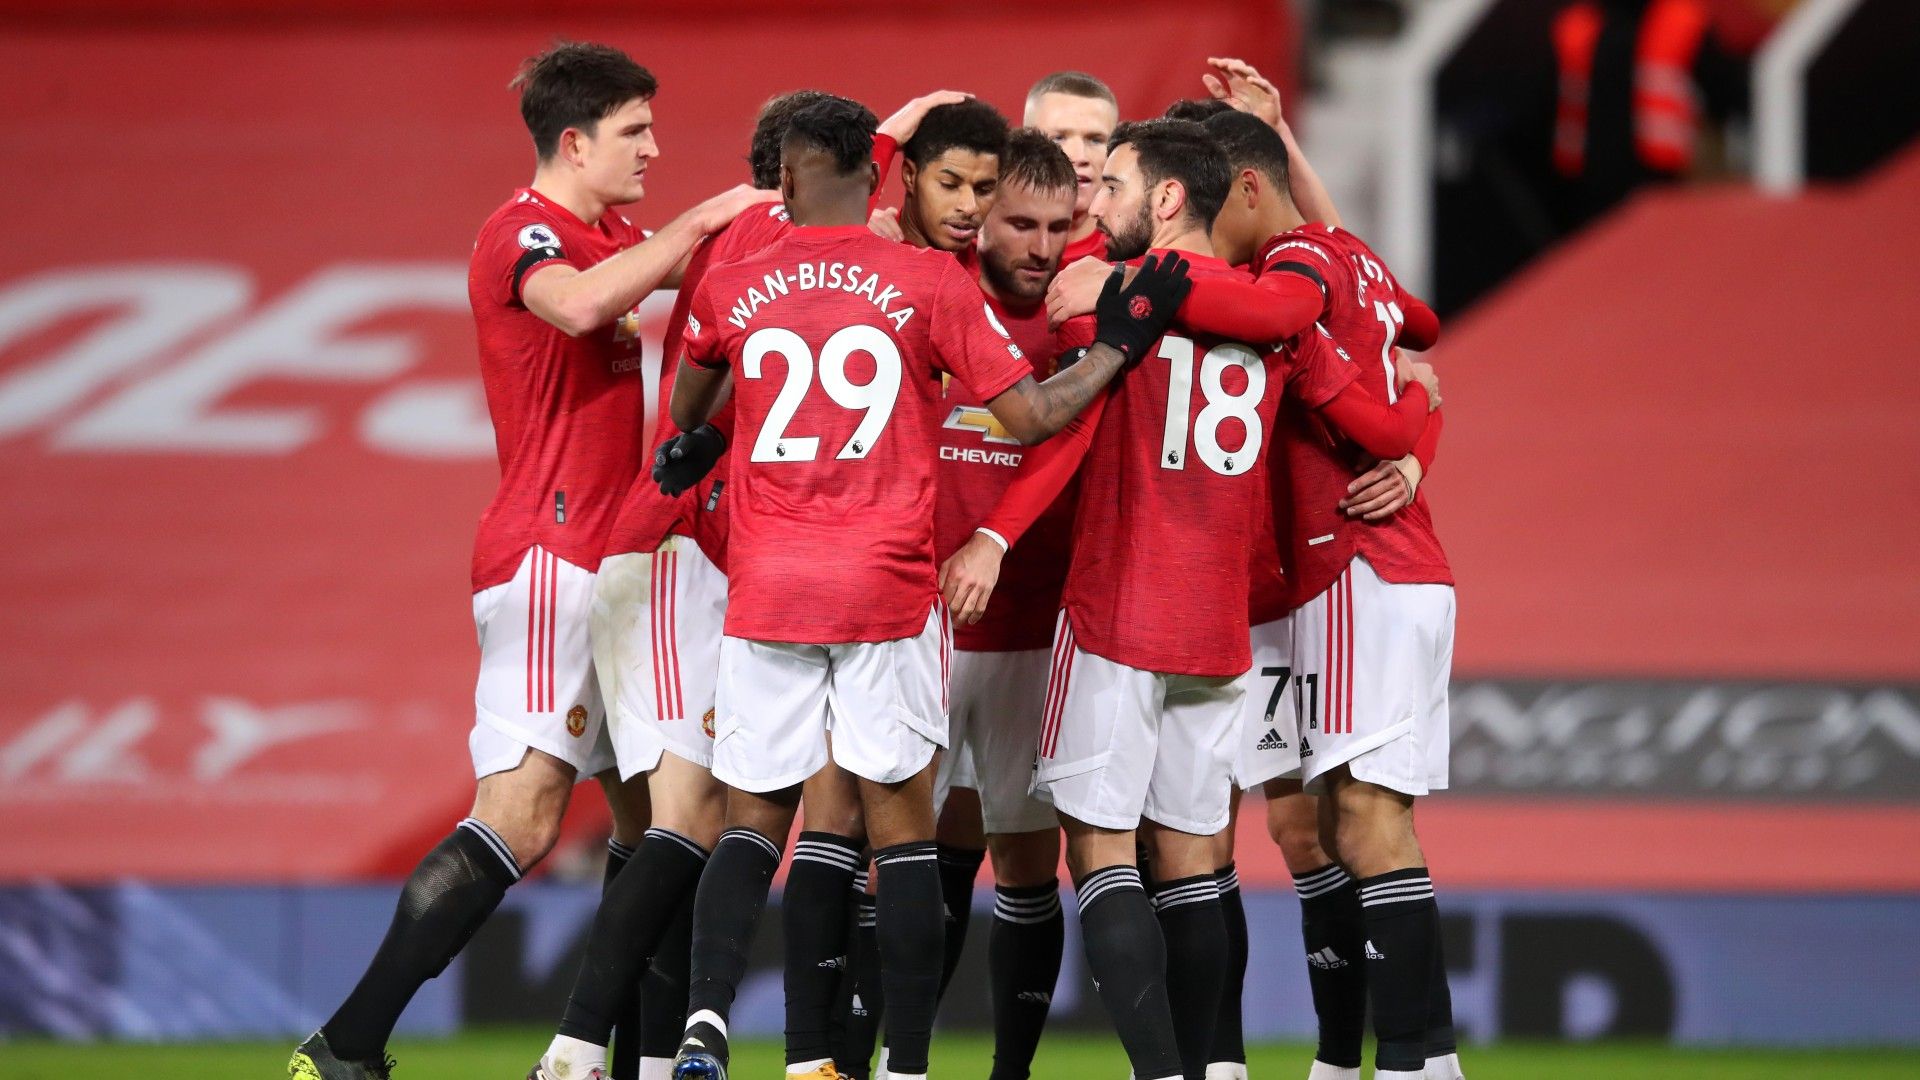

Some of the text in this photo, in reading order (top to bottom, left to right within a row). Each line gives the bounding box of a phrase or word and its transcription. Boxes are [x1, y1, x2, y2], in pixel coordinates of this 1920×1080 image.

[727, 262, 915, 333] WAN-BISSAKA
[742, 324, 902, 463] 29
[1157, 335, 1267, 476] 18
[1260, 667, 1290, 722] 7
[1296, 673, 1318, 729] 11
[1257, 742, 1288, 751] adidas
